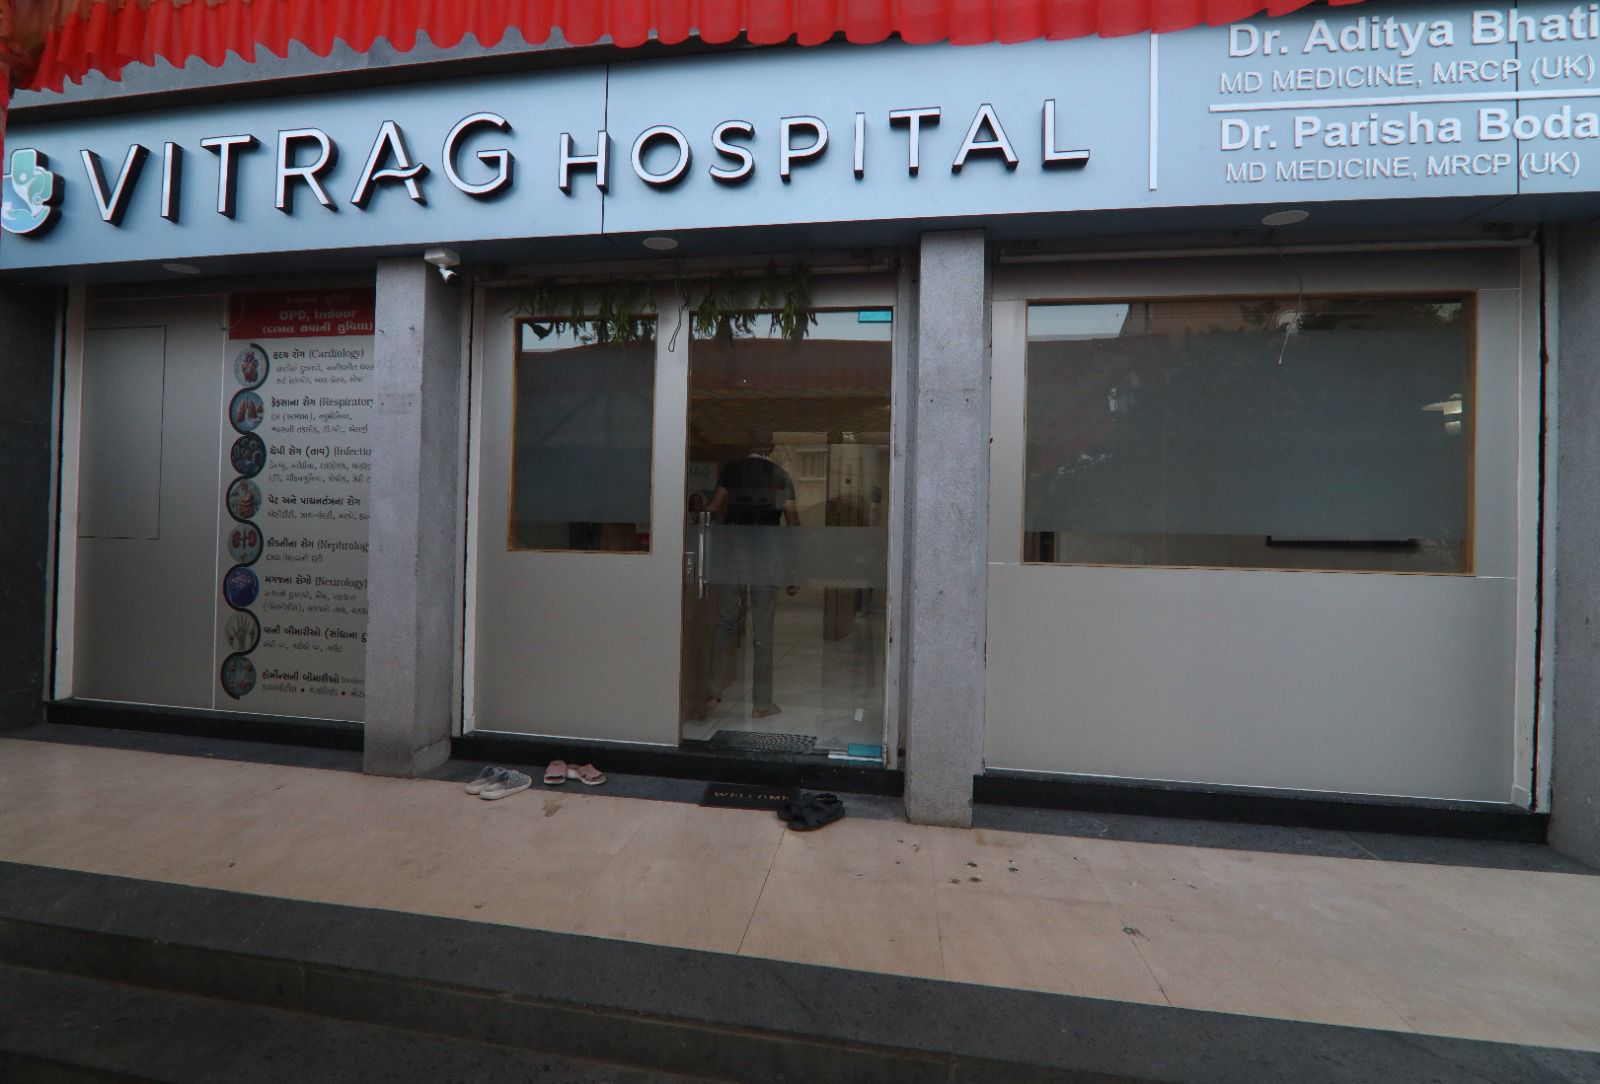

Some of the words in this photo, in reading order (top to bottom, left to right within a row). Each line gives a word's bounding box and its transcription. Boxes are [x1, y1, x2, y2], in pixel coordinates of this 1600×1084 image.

[1229, 23, 1288, 58] Dr.
[1303, 15, 1454, 58] Aditya
[1471, 4, 1599, 44] Bhati
[1219, 71, 1263, 94] MD
[1272, 64, 1423, 90] MEDICINE,
[1432, 58, 1521, 83] MRCP
[1530, 54, 1596, 85] (UK)
[1220, 117, 1277, 151] Dr.
[1293, 111, 1462, 149] Parisha
[1478, 105, 1600, 142] Boda
[80, 111, 515, 227] VITRAG
[558, 98, 1091, 197] HOSPITAL
[1225, 162, 1267, 183] MD
[1275, 156, 1418, 181] MEDICINE,
[1426, 152, 1511, 177] MRCP
[1520, 150, 1581, 179] (UK)
[309, 348, 364, 360] (Cardiology)
